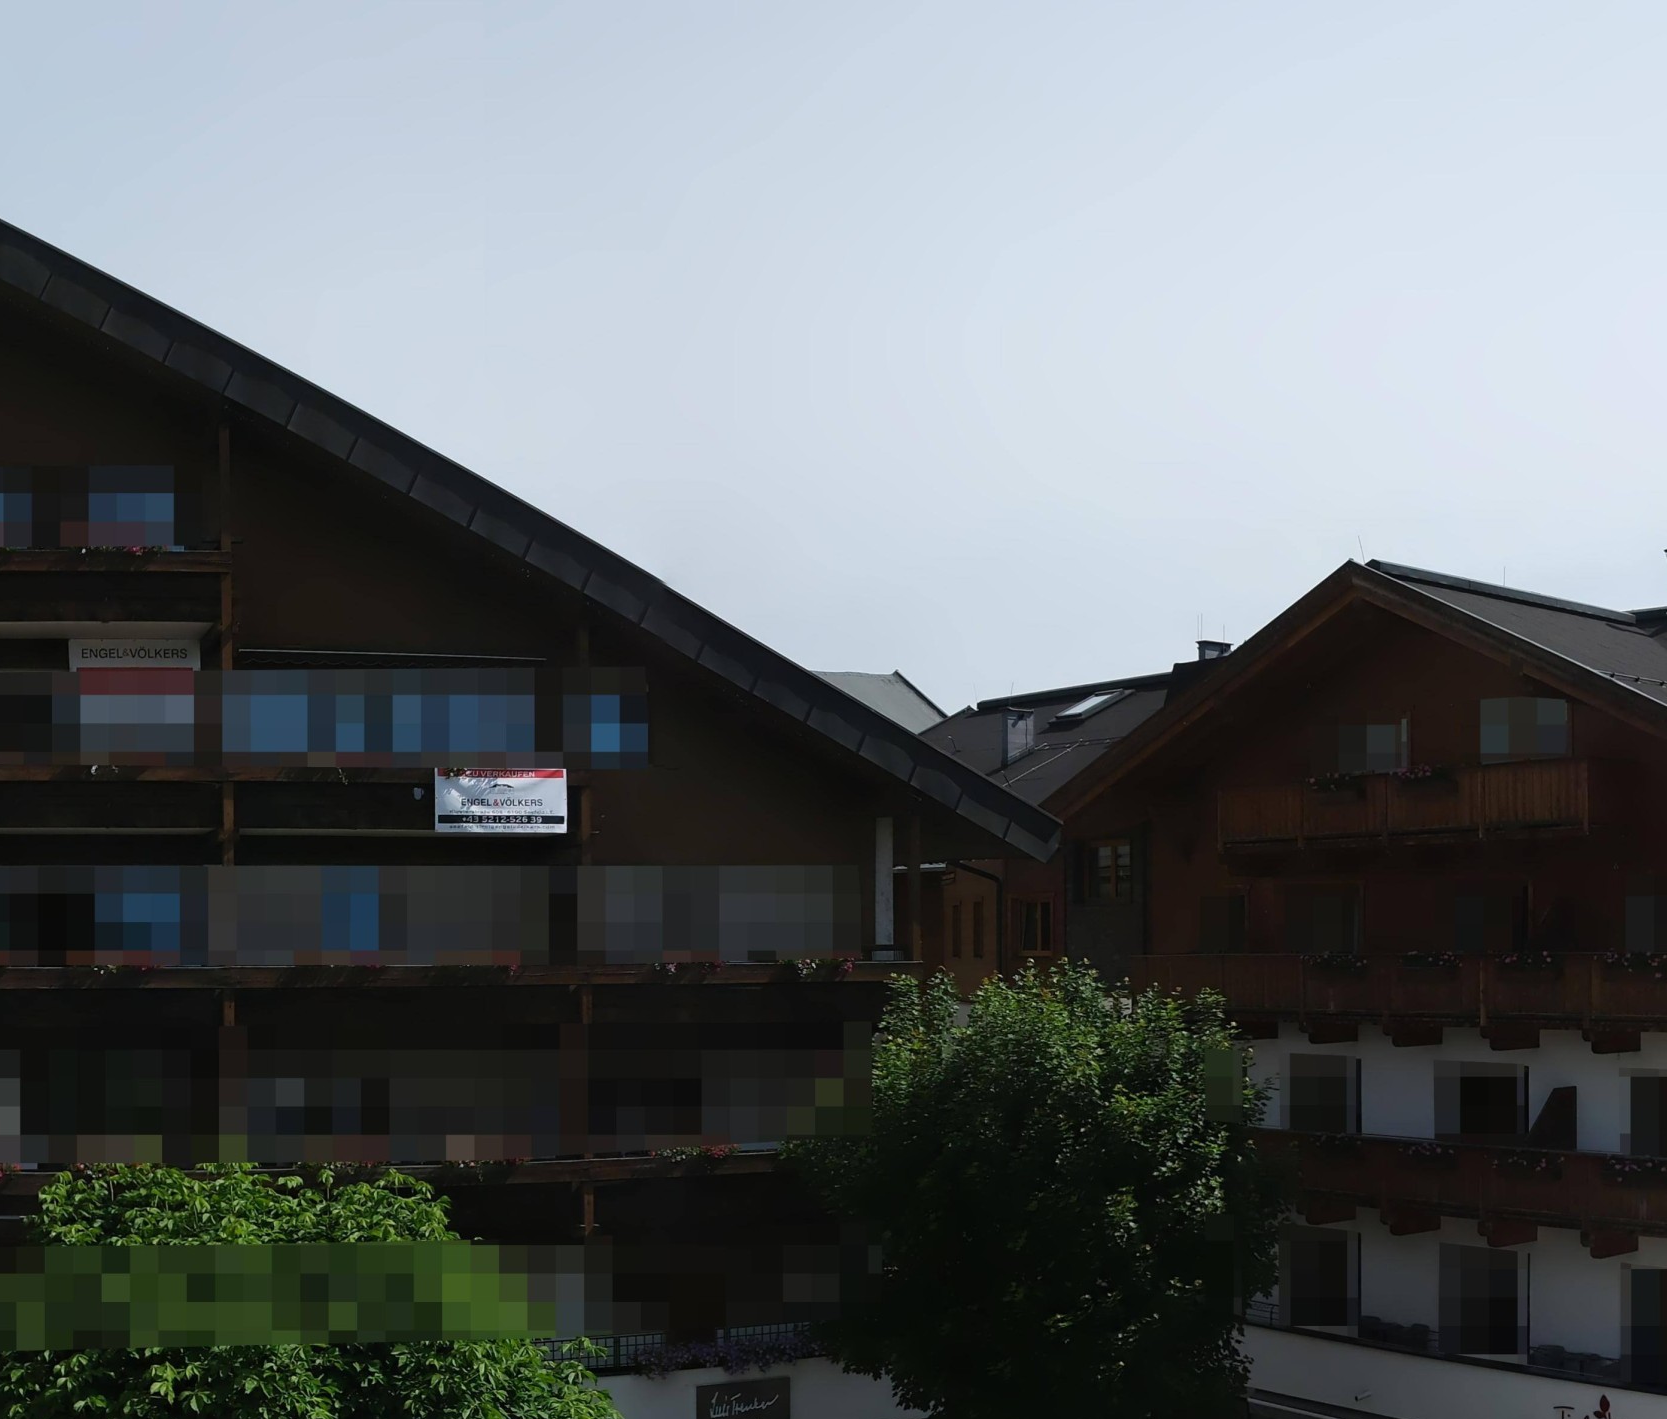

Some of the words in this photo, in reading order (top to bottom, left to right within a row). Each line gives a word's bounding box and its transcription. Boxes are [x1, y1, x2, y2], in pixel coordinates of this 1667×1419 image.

[81, 646, 188, 659] ENGEL&VÖLKERS
[481, 770, 535, 778] VERKAUFEN
[461, 797, 543, 807] ENGEL&VÖLKERS
[462, 815, 479, 823] +43
[482, 815, 528, 823] 5212-526
